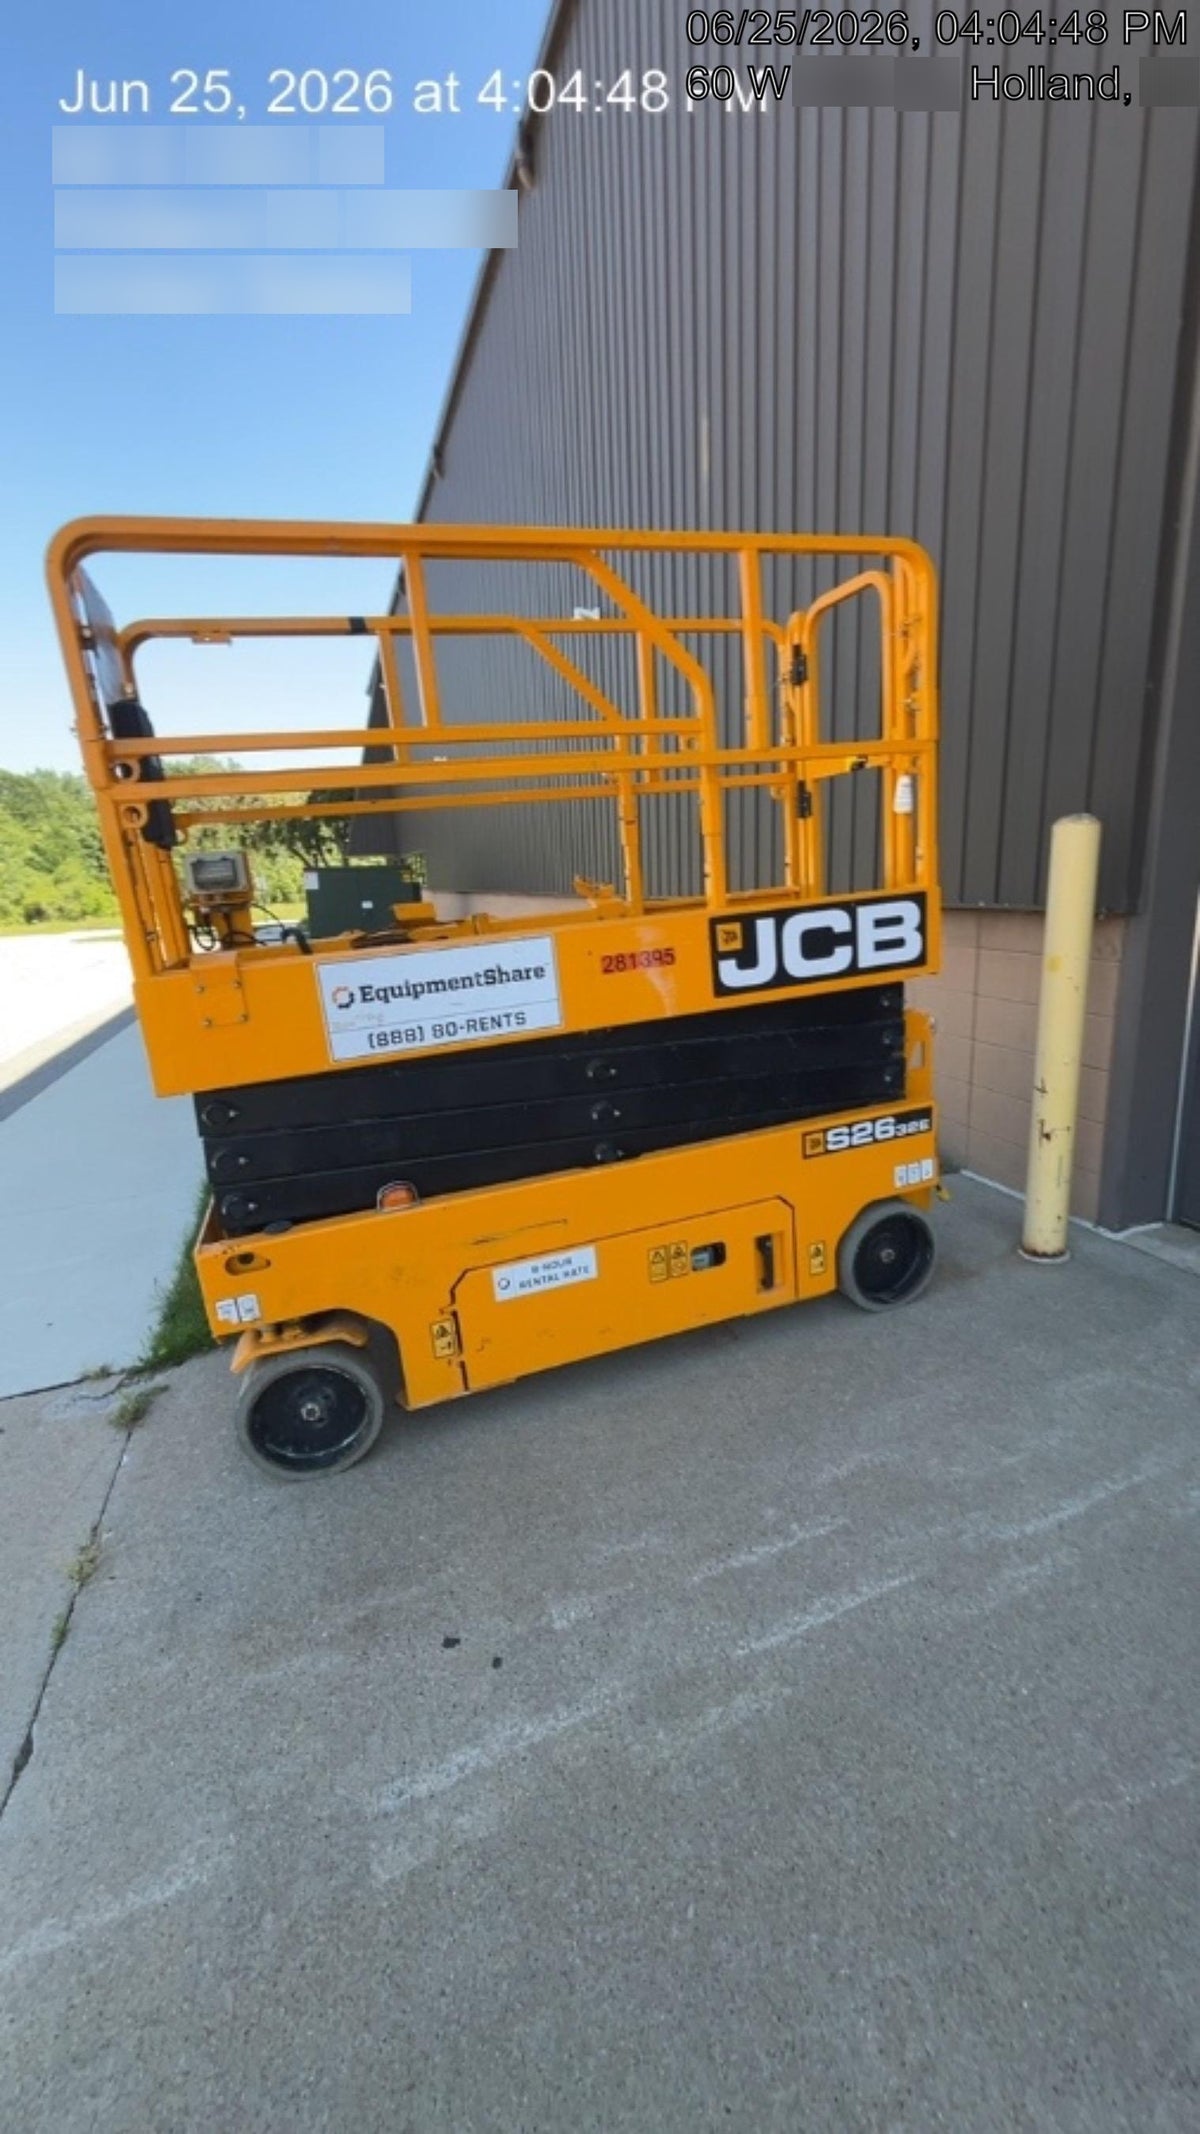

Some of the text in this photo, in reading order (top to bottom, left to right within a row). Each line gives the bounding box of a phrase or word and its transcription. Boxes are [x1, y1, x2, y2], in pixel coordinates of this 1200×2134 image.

[601, 947, 676, 974] 281395
[717, 900, 924, 988] JCB
[358, 964, 546, 1004] EquipmentShare
[431, 1011, 527, 1040] 80-RENTS
